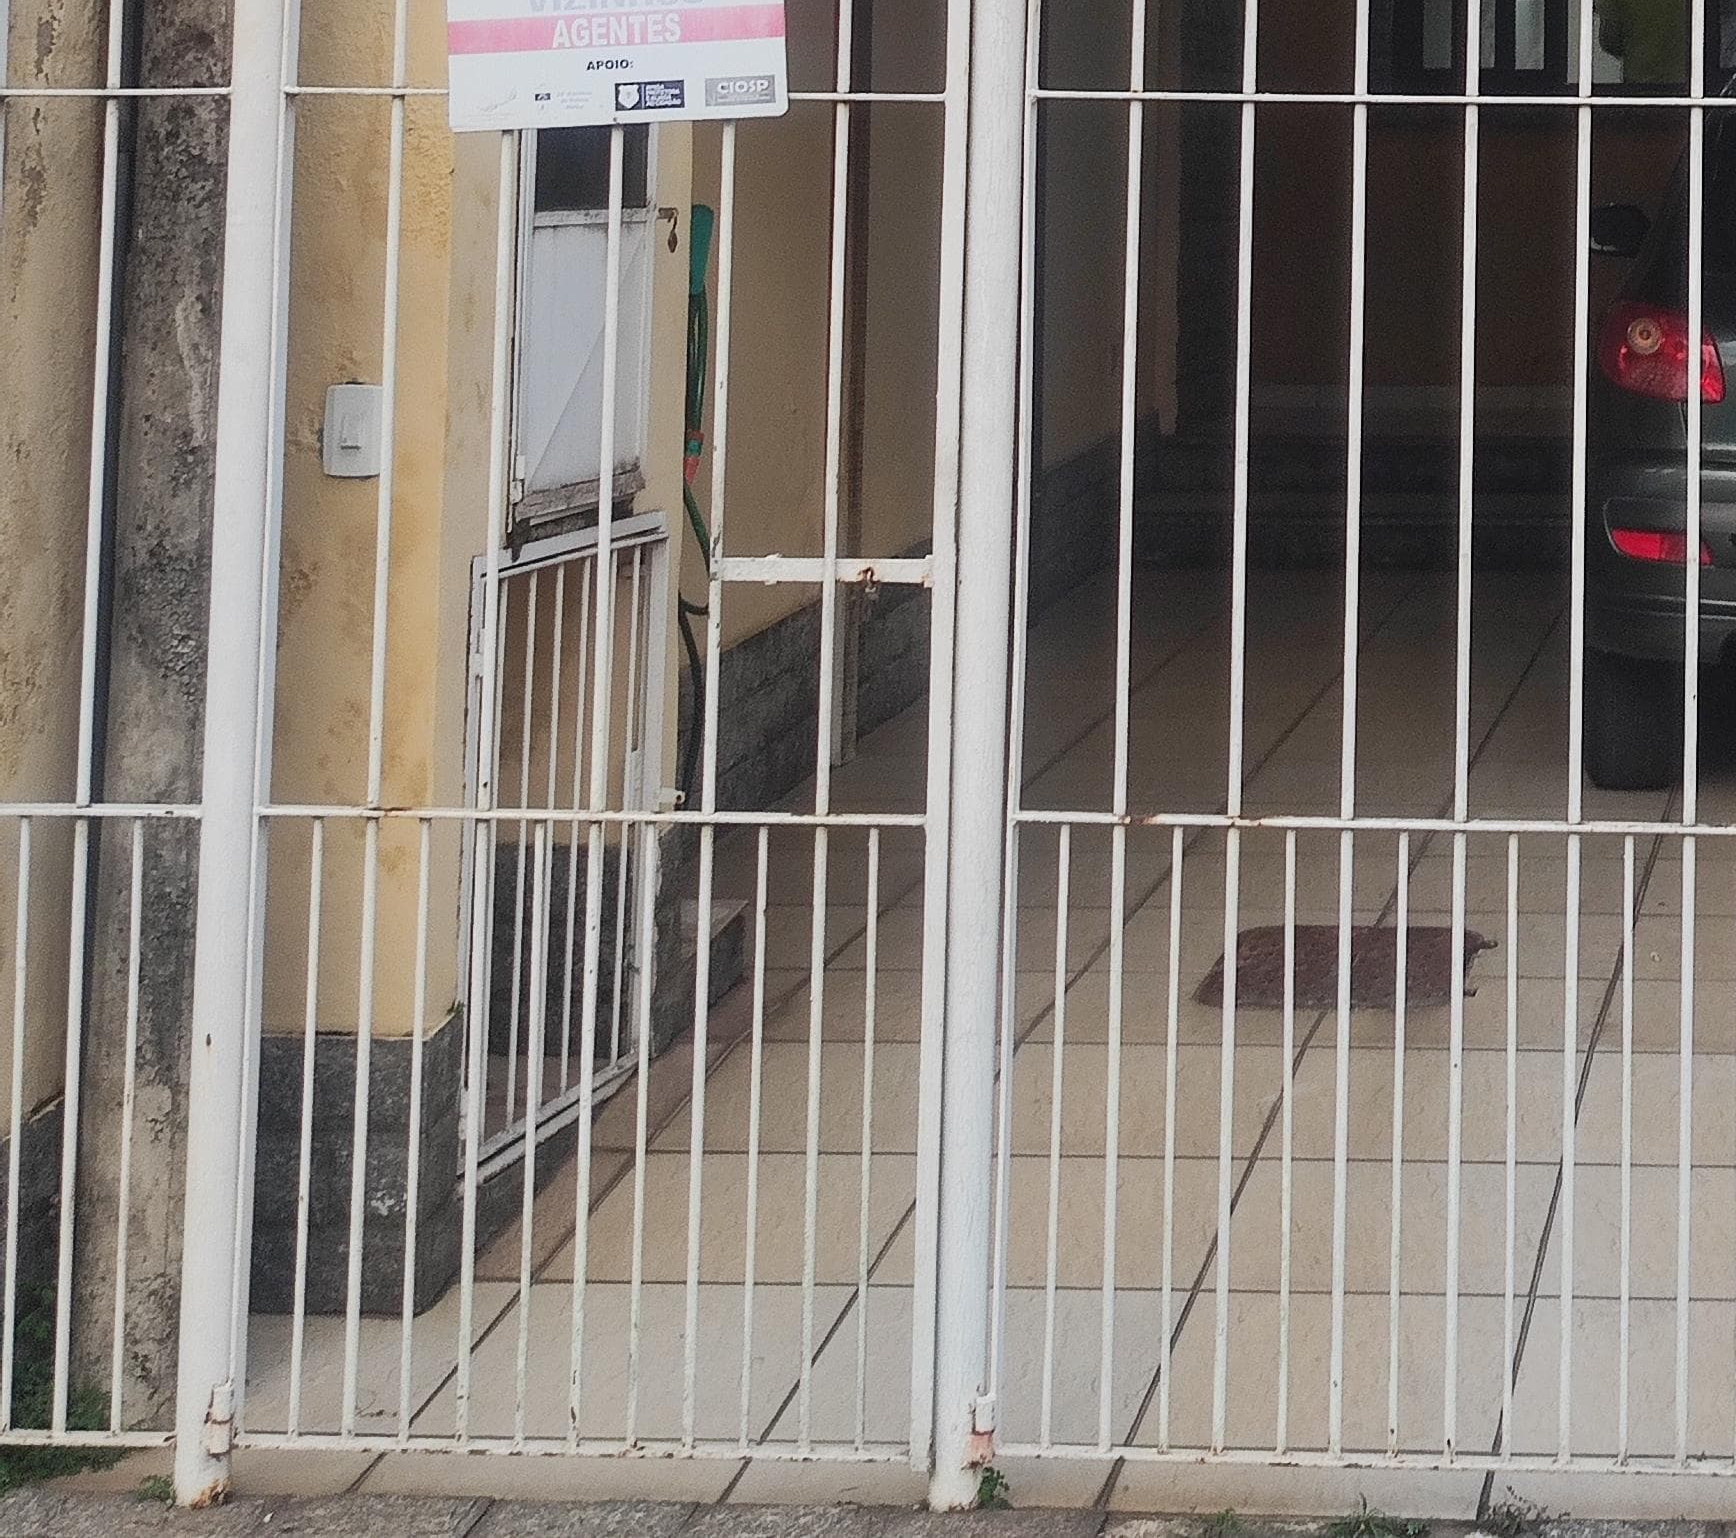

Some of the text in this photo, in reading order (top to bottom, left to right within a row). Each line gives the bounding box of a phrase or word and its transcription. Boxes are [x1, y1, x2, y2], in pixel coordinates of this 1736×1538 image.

[552, 13, 681, 49] AGENTES
[586, 59, 634, 71] APOIO:
[717, 79, 770, 94] CIOSP
